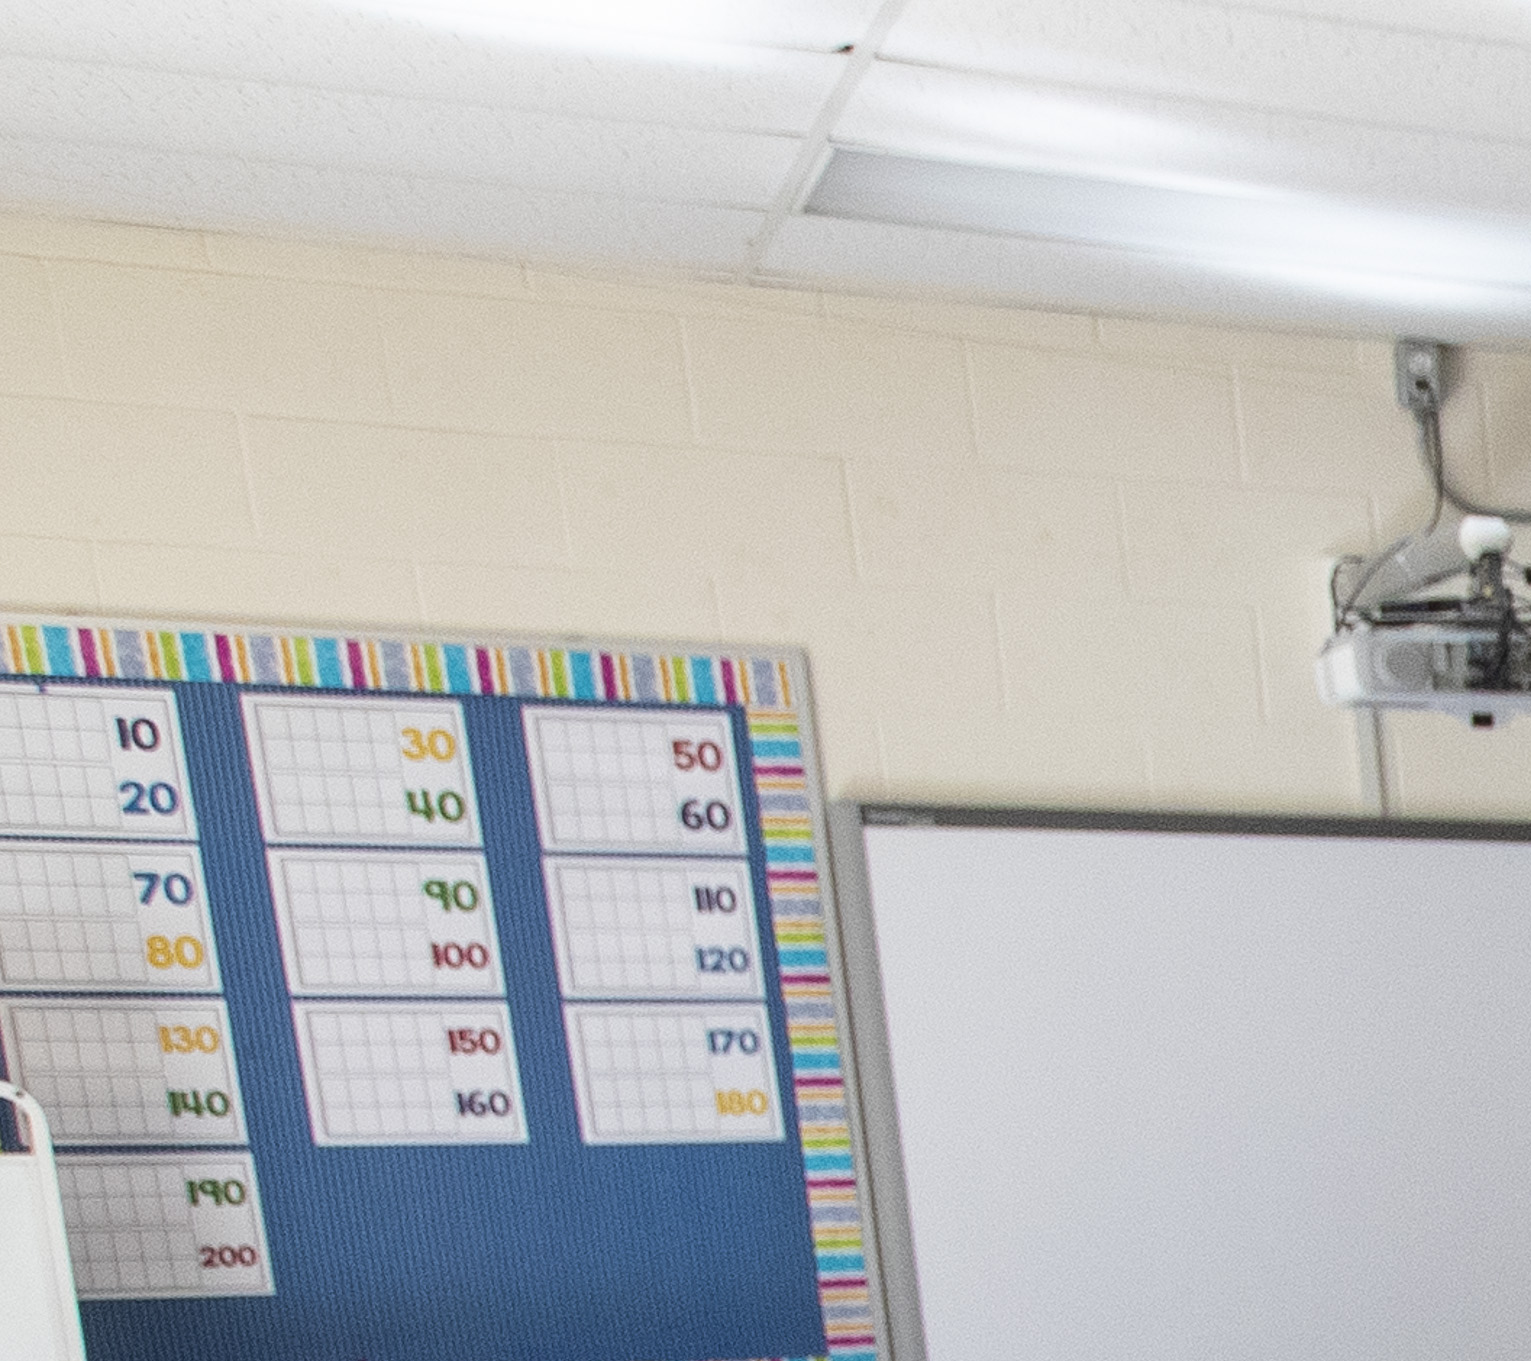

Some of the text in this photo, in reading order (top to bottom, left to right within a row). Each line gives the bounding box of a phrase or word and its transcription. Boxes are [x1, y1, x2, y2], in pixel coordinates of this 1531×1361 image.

[116, 718, 160, 750] 10
[401, 729, 456, 762] 30
[672, 739, 723, 772] 50
[120, 781, 177, 816] 20
[406, 790, 465, 824] 40
[680, 800, 731, 831] 60
[134, 873, 193, 905] 70
[423, 881, 478, 912] 90
[693, 886, 737, 914] 110
[146, 935, 203, 970] 80
[430, 942, 489, 970] 100
[696, 947, 750, 973] 120
[158, 1025, 220, 1054] 130
[447, 1027, 501, 1055] 150
[707, 1028, 761, 1054] 170
[167, 1090, 231, 1118] 140
[456, 1090, 511, 1117] 160
[715, 1091, 768, 1116] 180
[185, 1179, 245, 1206] 190
[200, 1245, 257, 1268] 200
